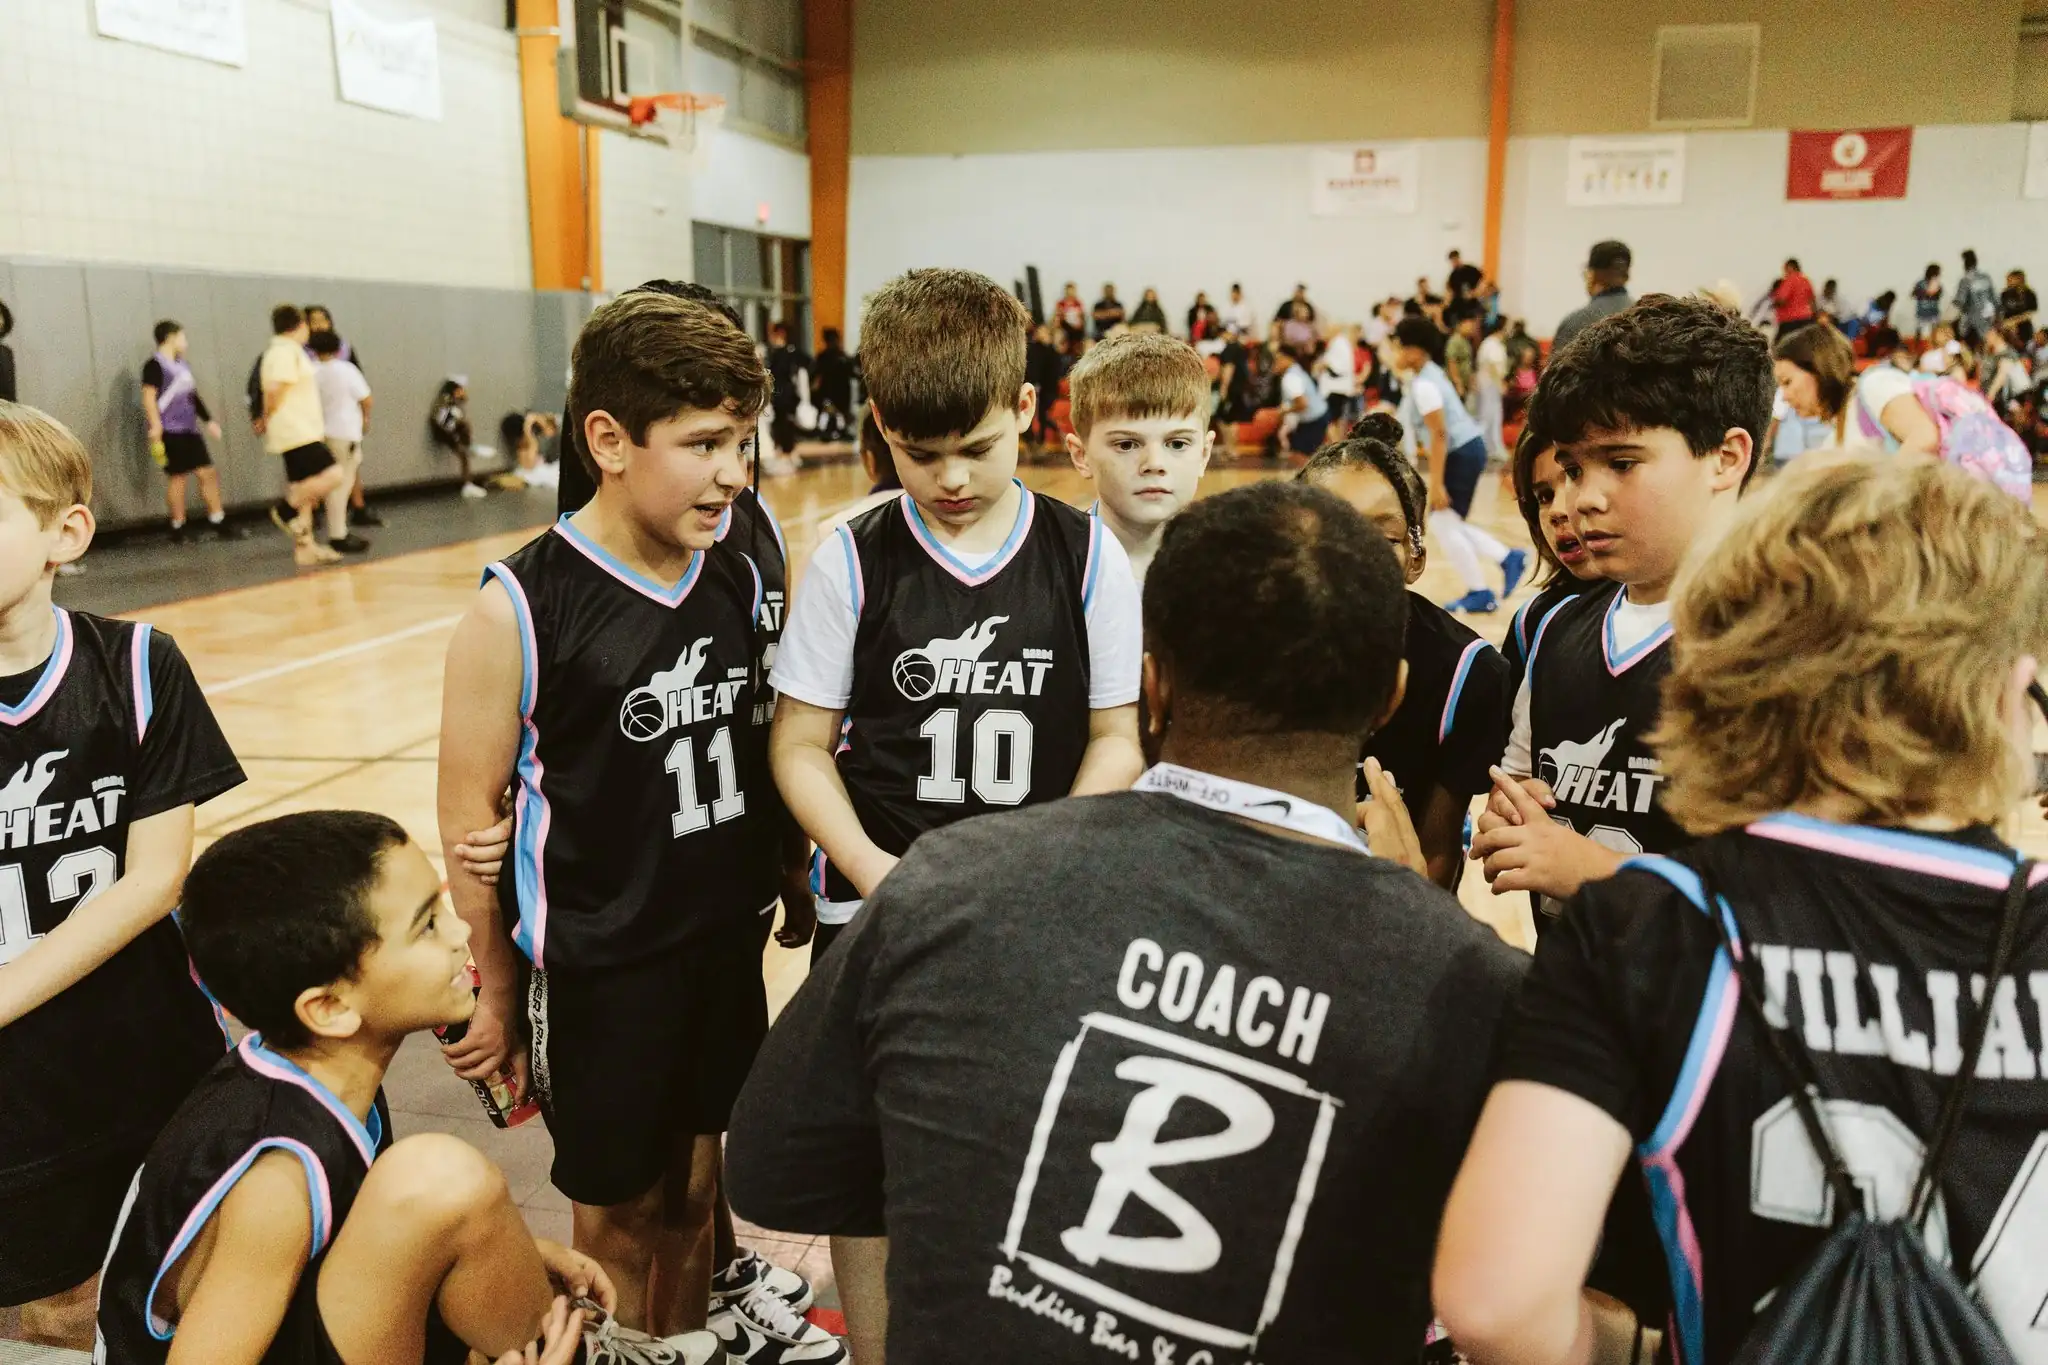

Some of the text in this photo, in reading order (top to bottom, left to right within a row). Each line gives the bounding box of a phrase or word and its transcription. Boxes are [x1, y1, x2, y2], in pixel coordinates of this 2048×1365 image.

[760, 602, 784, 631] AT
[668, 680, 748, 728] HEAT
[937, 659, 1053, 696] HEAT
[664, 726, 746, 839] 11
[917, 708, 1034, 806] 10
[1555, 764, 1664, 814] HEAT
[0, 789, 127, 850] HEAT
[1117, 938, 1330, 1065] COACH
[1751, 943, 2048, 1080] ILLIA
[1061, 1055, 1275, 1274] B
[988, 1265, 1085, 1334] Buddies
